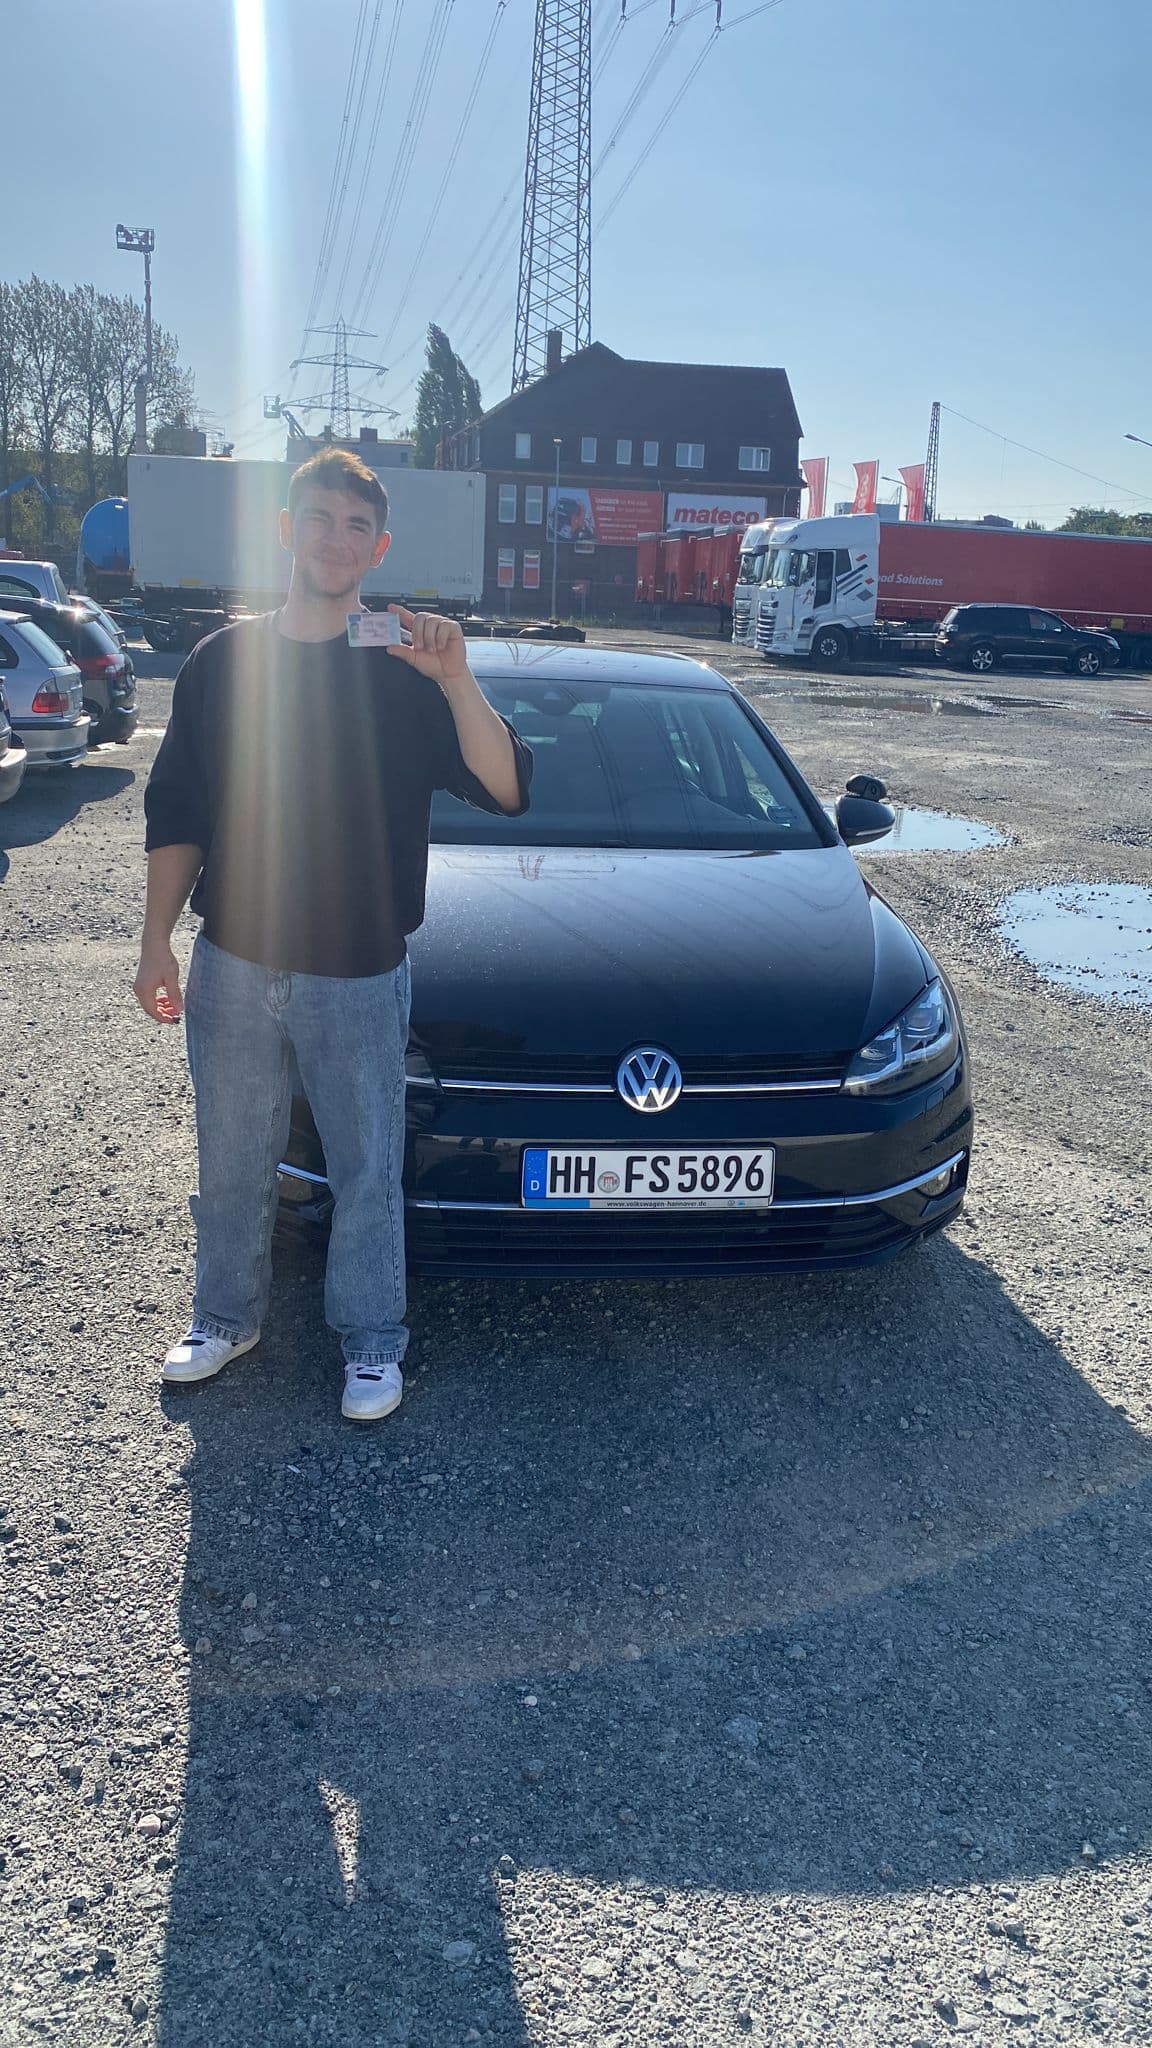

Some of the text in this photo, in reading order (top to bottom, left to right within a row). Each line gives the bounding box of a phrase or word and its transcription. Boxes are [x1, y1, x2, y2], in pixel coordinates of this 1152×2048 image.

[673, 506, 760, 526] mateco
[896, 574, 944, 586] Solutions
[549, 1156, 597, 1193] HH
[530, 1179, 540, 1192] D
